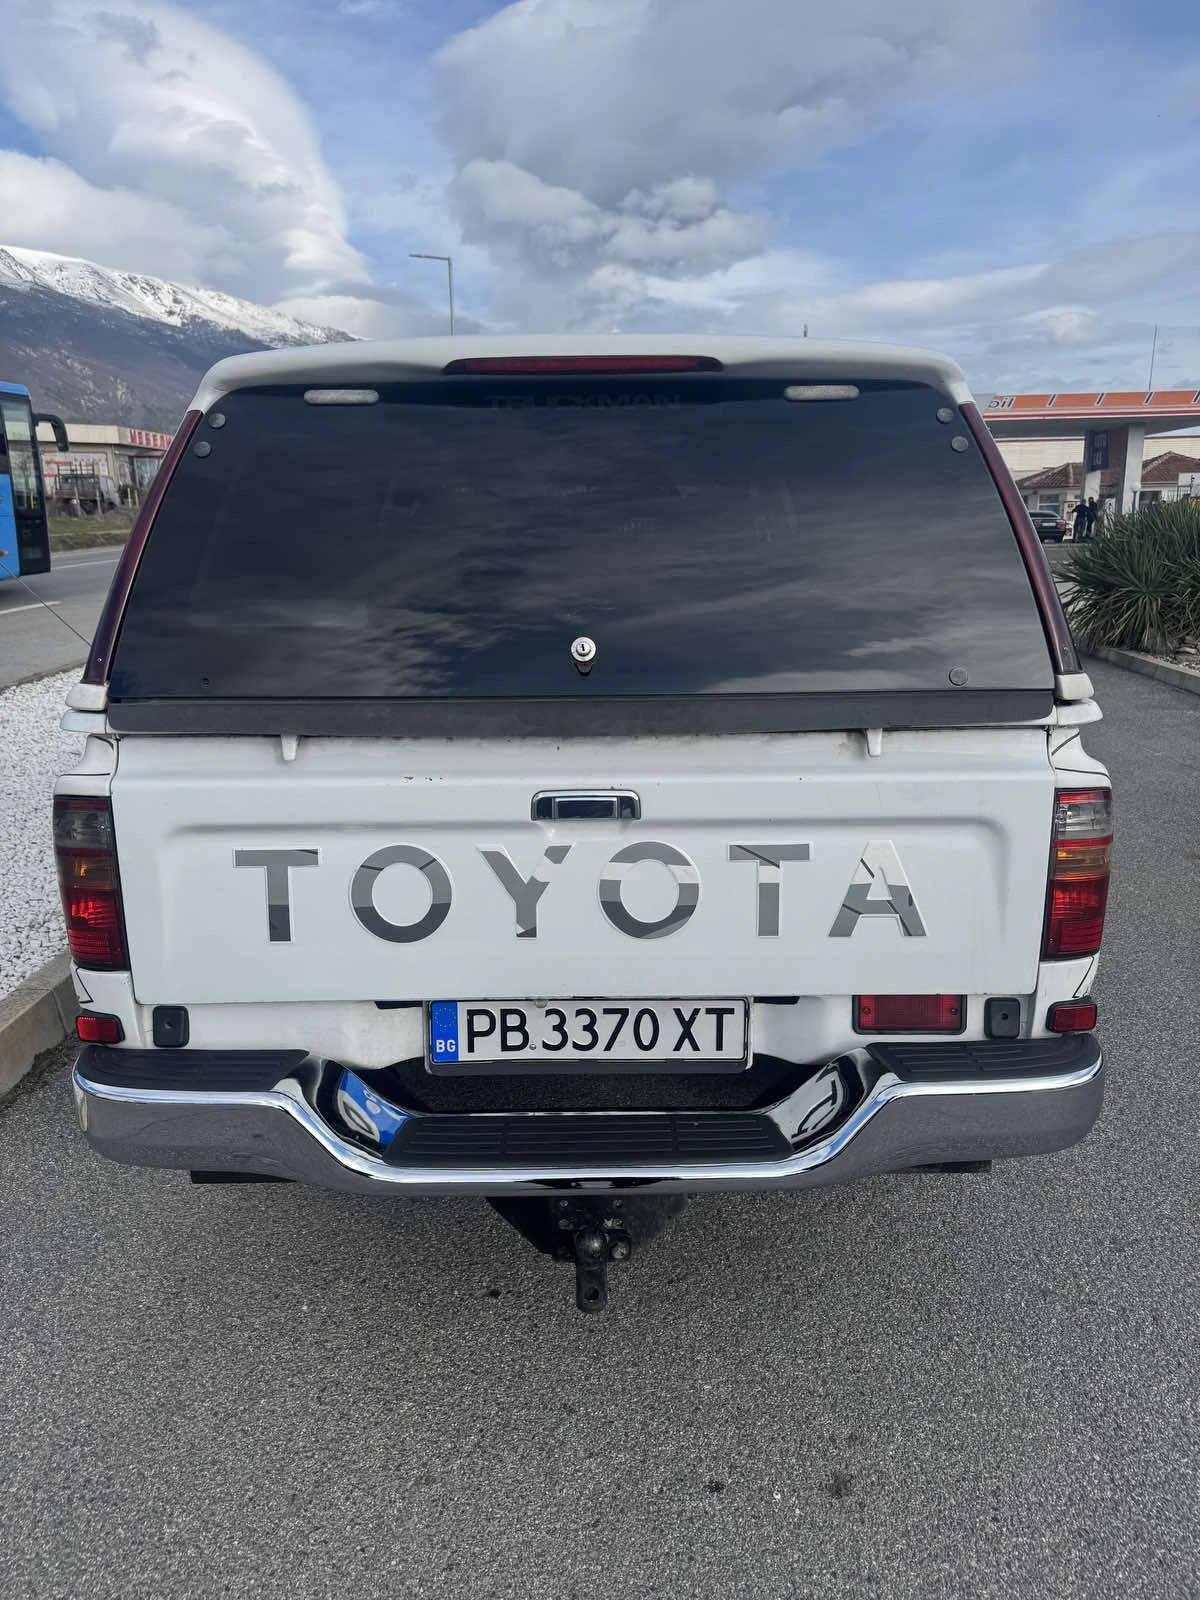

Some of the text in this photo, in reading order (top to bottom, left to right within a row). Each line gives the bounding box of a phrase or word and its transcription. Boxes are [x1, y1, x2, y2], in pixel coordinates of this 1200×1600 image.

[233, 840, 929, 944] TOYOTA
[435, 1039, 456, 1053] BG
[466, 1007, 736, 1053] PB 3370 XT
